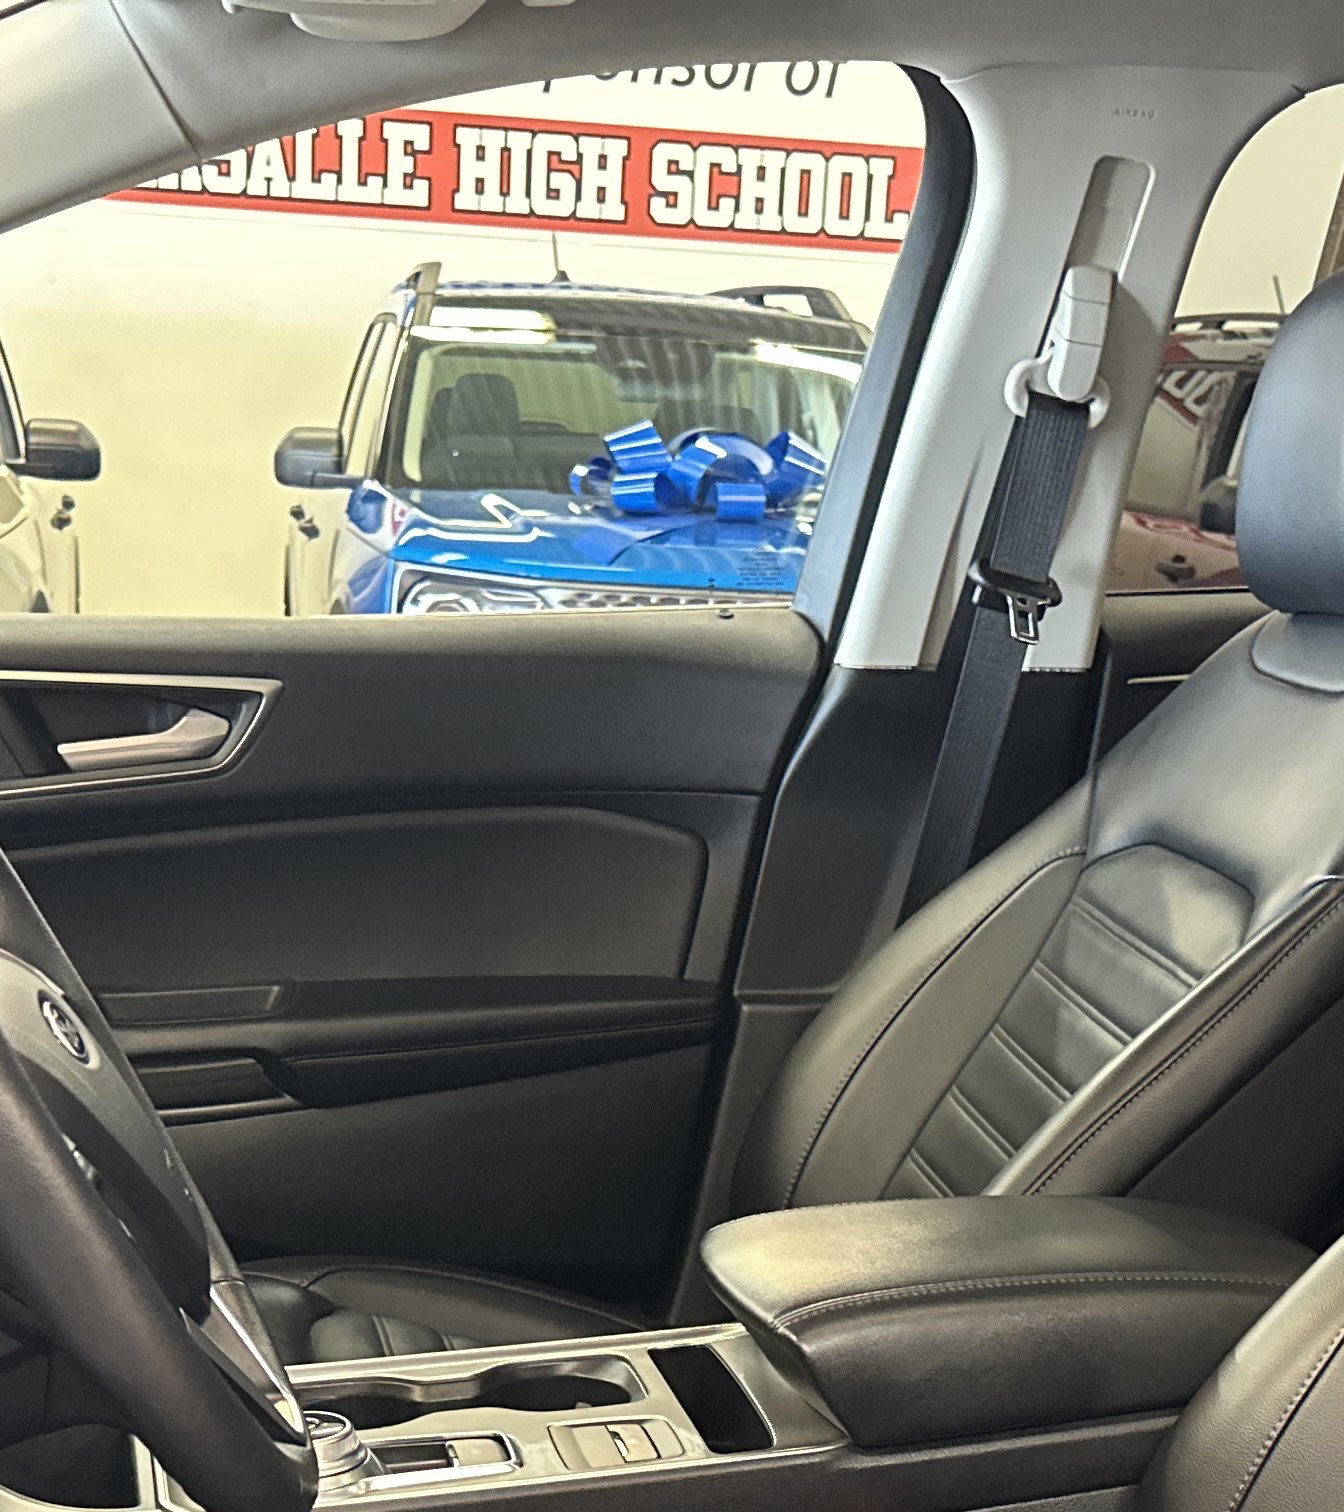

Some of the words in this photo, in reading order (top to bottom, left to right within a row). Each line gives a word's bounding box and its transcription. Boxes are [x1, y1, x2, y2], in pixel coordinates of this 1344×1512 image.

[134, 116, 431, 210] SALLE
[453, 124, 630, 224] HIGH
[649, 139, 910, 241] SCHOOL
